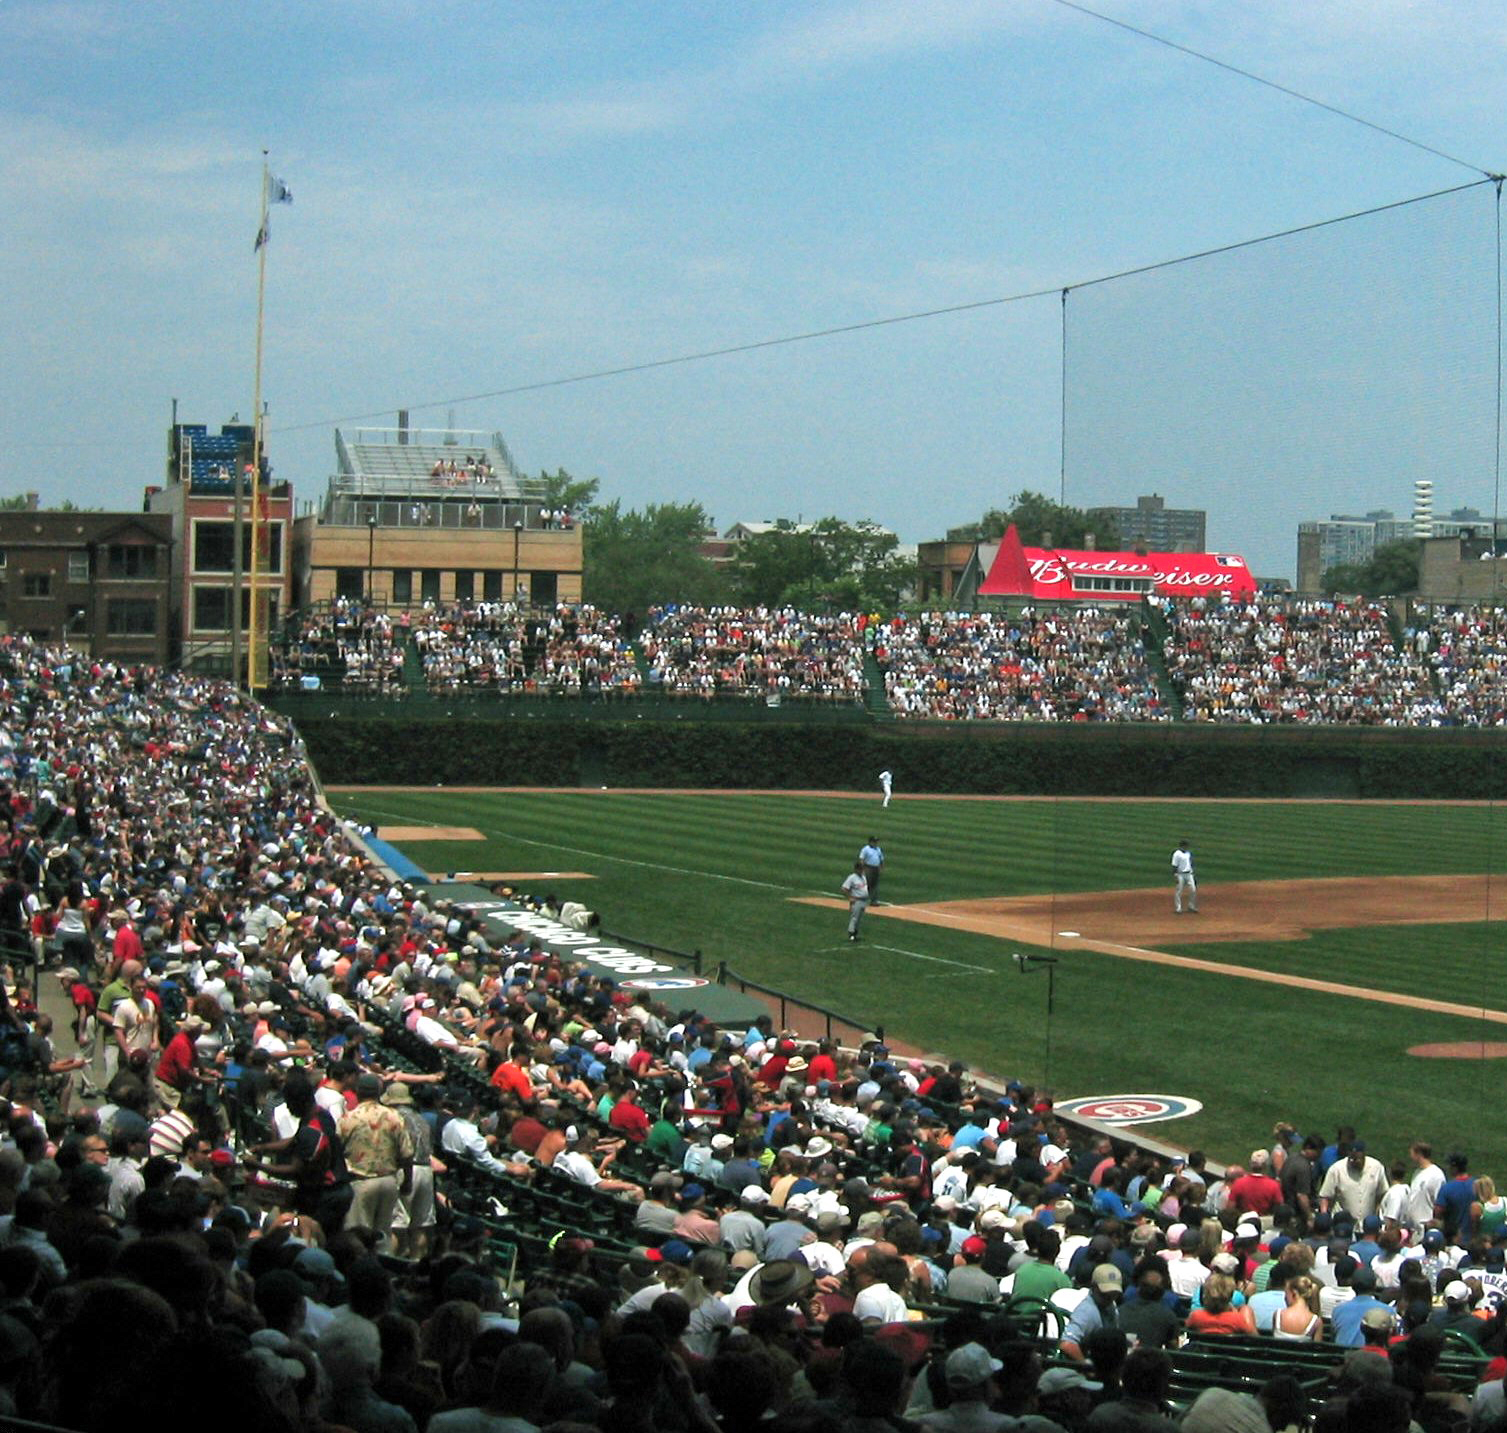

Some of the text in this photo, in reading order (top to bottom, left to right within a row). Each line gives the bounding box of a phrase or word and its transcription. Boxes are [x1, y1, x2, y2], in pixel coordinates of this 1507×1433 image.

[1027, 556, 1232, 586] Budweiser
[488, 911, 600, 945] CHICAGO
[572, 947, 673, 974] CUBS
